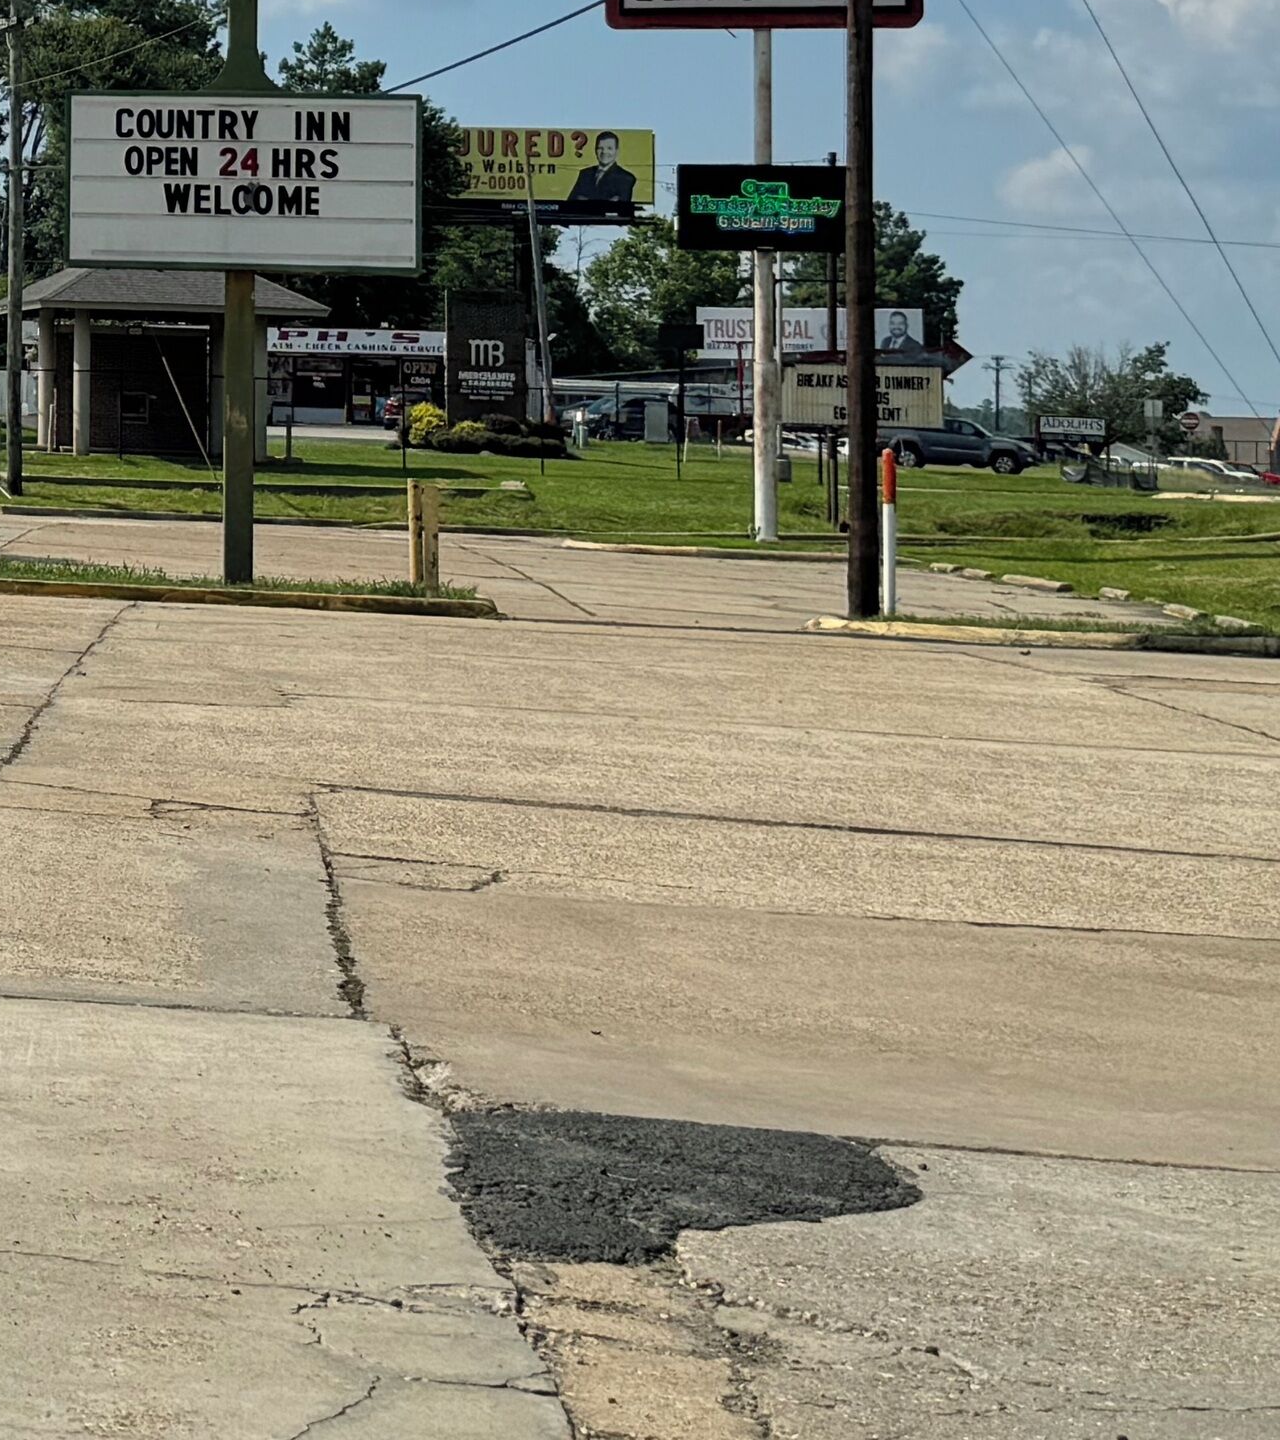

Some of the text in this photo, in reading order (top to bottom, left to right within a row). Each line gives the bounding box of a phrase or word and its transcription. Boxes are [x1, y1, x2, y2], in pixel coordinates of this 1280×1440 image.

[115, 108, 351, 142] COUNTRY INN
[456, 129, 589, 158] JURED?
[124, 146, 339, 179] OPEN 24 HRS
[163, 183, 320, 216] WELCOME
[271, 342, 293, 350] ATM
[347, 343, 396, 352] CASHING
[403, 345, 443, 353] SERVIC
[403, 361, 437, 375] OPEN
[797, 373, 848, 389] BREAKFAS
[884, 376, 931, 390] DINNER?
[1043, 416, 1103, 432] ADOLPH'S
